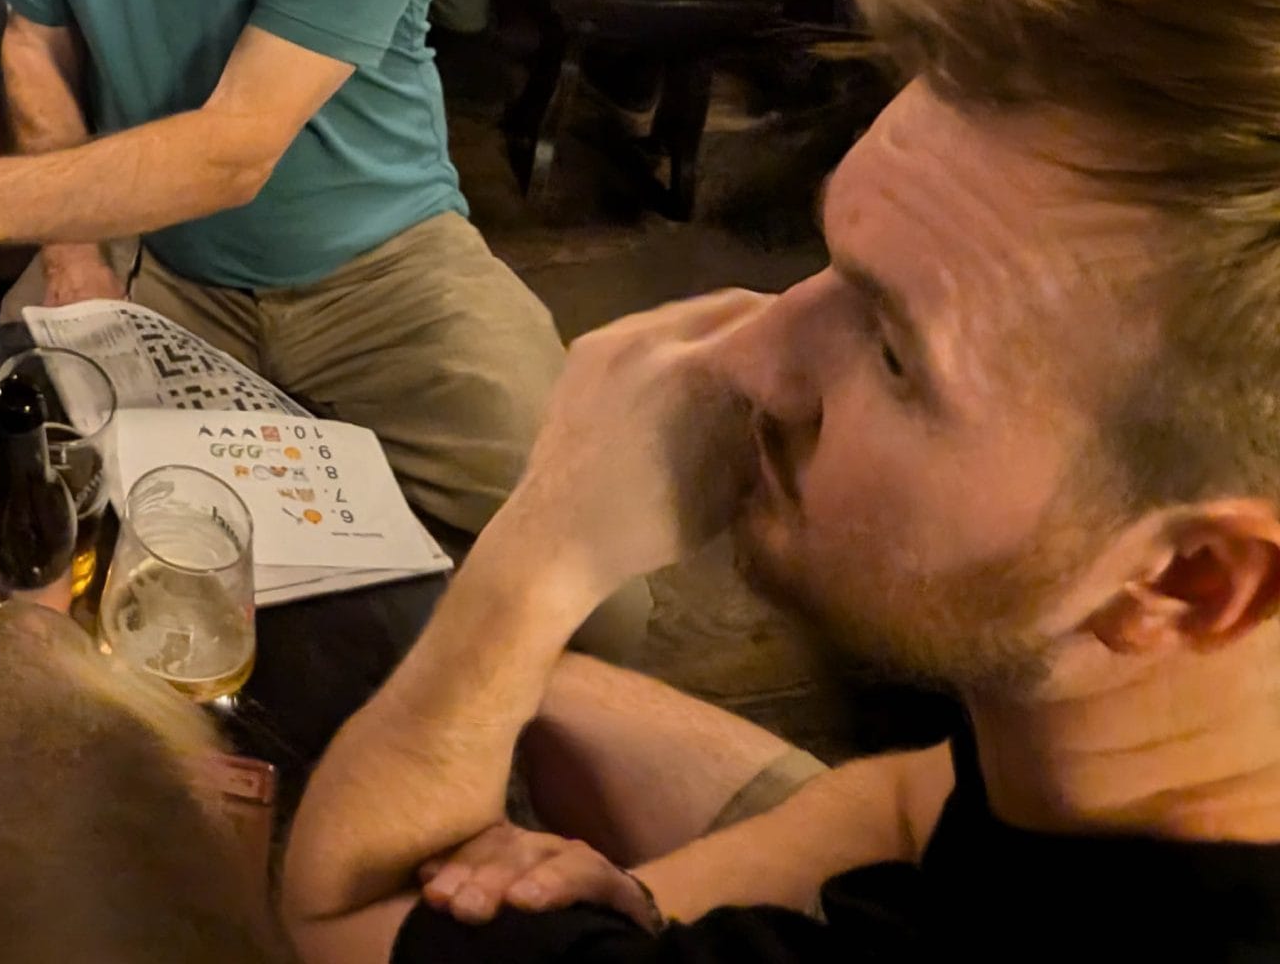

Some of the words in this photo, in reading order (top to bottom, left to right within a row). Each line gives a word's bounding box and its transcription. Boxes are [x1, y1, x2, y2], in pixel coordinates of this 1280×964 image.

[285, 425, 324, 440] 10.
[316, 465, 338, 480] 8.
[324, 487, 349, 503] 7.
